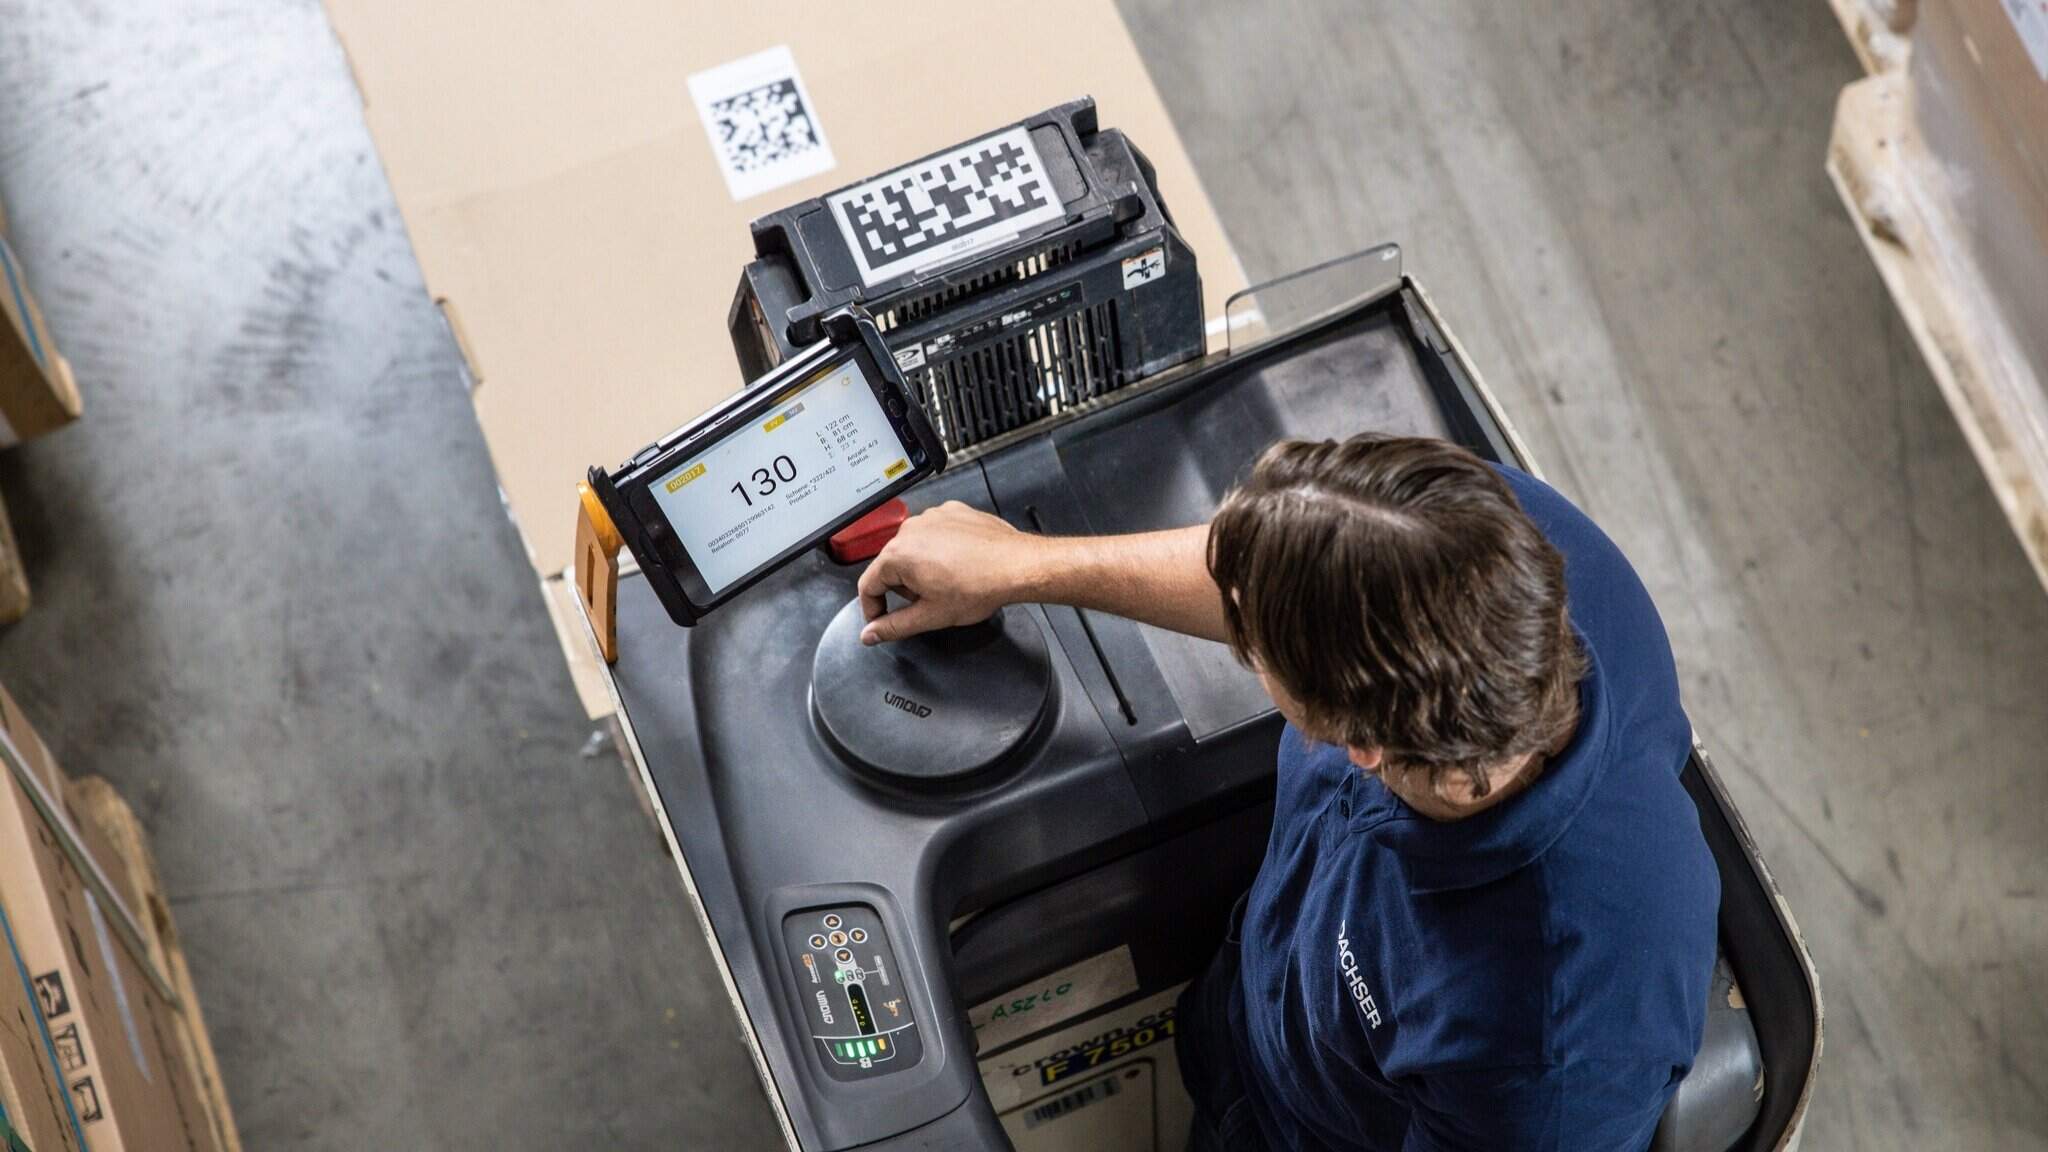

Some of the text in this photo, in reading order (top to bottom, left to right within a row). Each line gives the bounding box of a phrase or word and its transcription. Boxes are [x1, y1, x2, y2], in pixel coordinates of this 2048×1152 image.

[839, 414, 850, 424] cm
[843, 421, 854, 430] cm
[847, 428, 858, 438] cm
[731, 455, 797, 506] 130
[1046, 1019, 1177, 1082] F 7501
